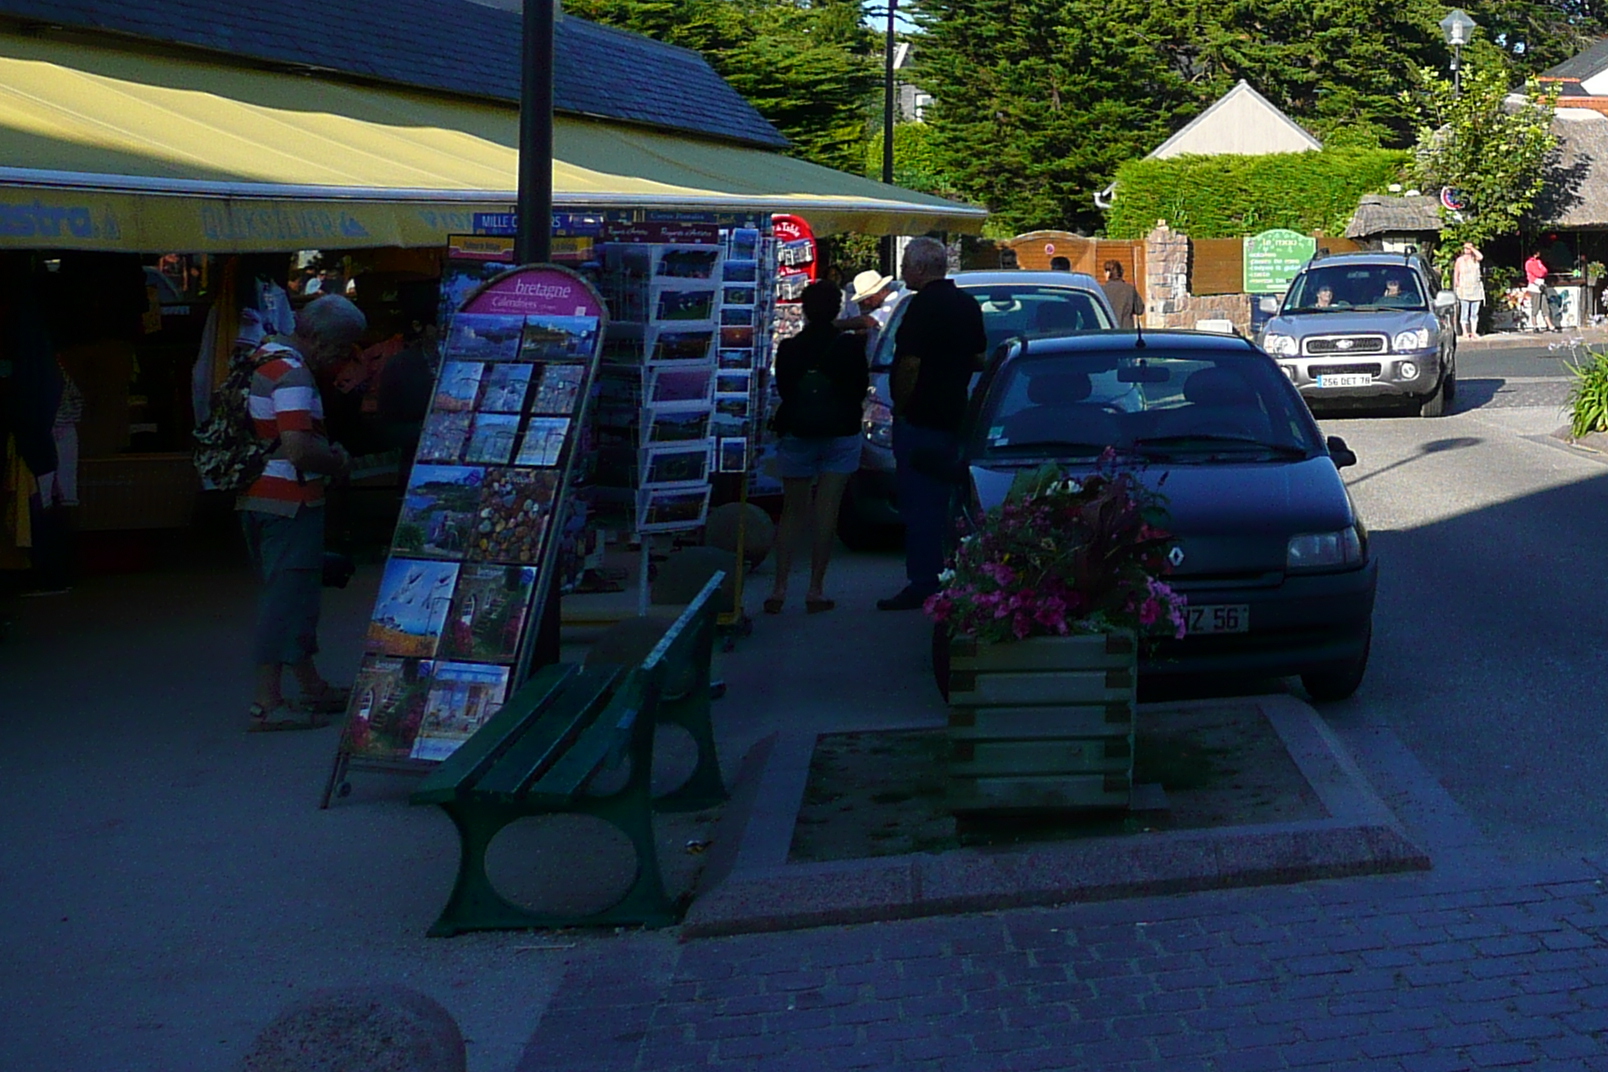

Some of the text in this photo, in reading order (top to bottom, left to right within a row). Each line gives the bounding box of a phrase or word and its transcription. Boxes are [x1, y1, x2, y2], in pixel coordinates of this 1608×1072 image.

[481, 215, 509, 228] MILLE
[515, 278, 571, 299] bretagne
[1214, 608, 1238, 629] 56
